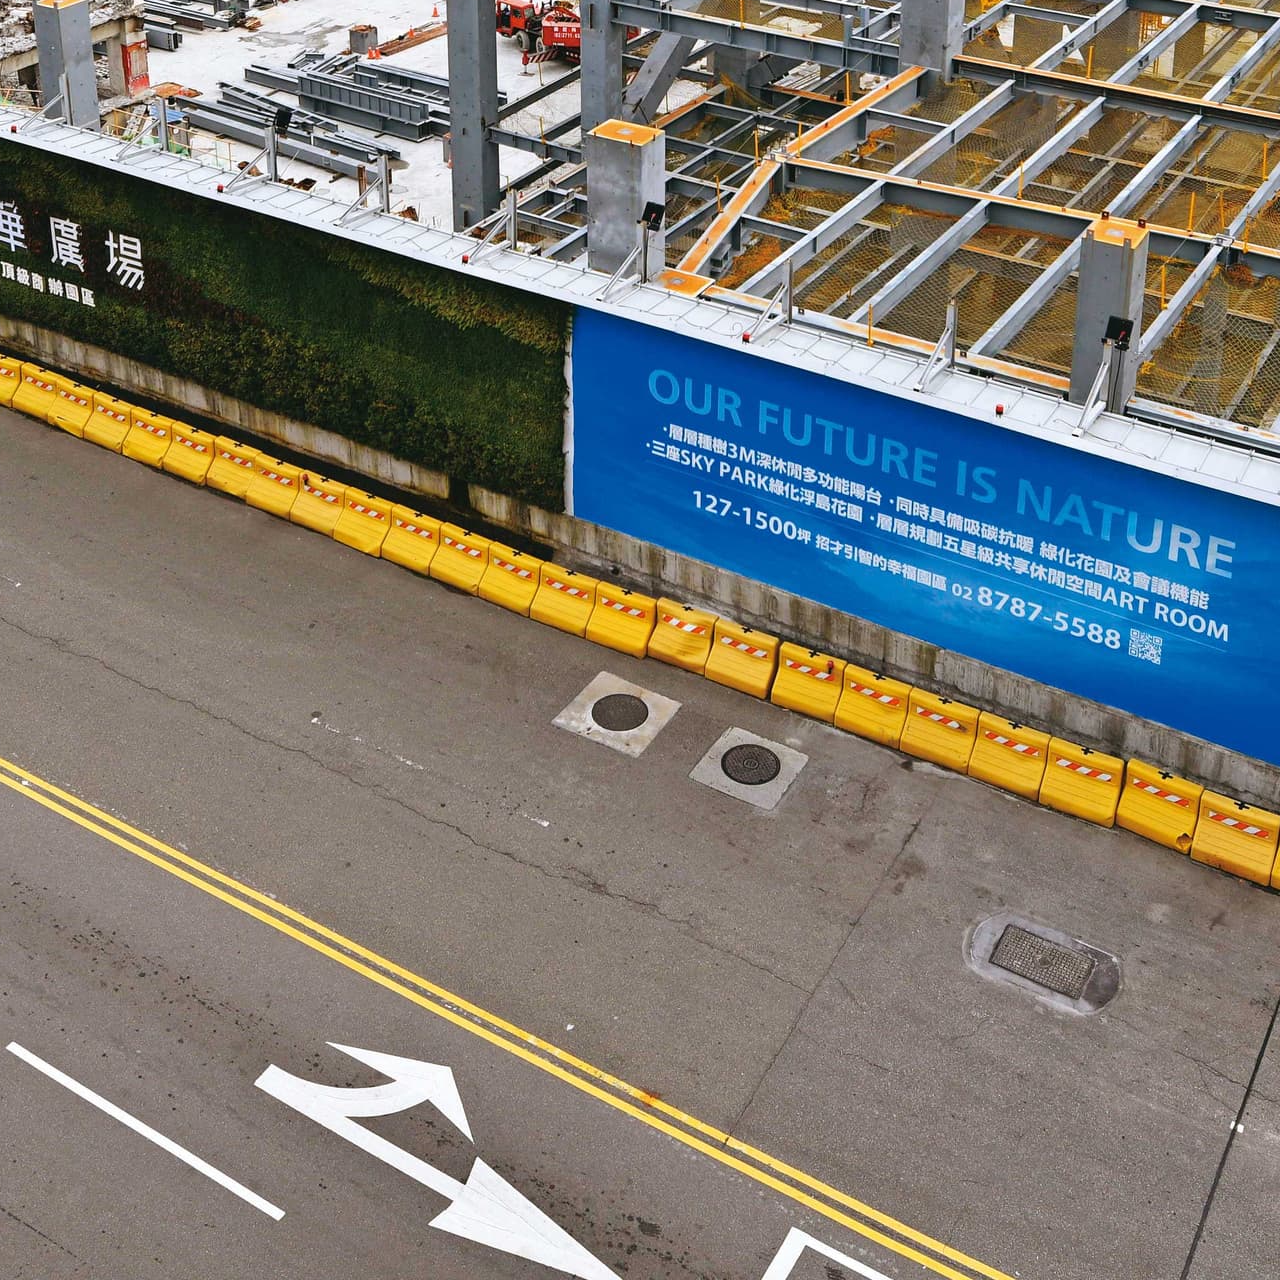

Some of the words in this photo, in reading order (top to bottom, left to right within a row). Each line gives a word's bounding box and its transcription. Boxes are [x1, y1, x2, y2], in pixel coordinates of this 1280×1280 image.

[648, 369, 742, 428] OUR
[758, 400, 939, 488] FUTURE
[956, 460, 998, 504] IS
[1016, 478, 1237, 580] NATURE
[692, 490, 812, 545] 127-1500坪
[951, 582, 973, 601] 02
[977, 586, 1121, 650] 8787-5588
[1154, 602, 1229, 643] ROOM
